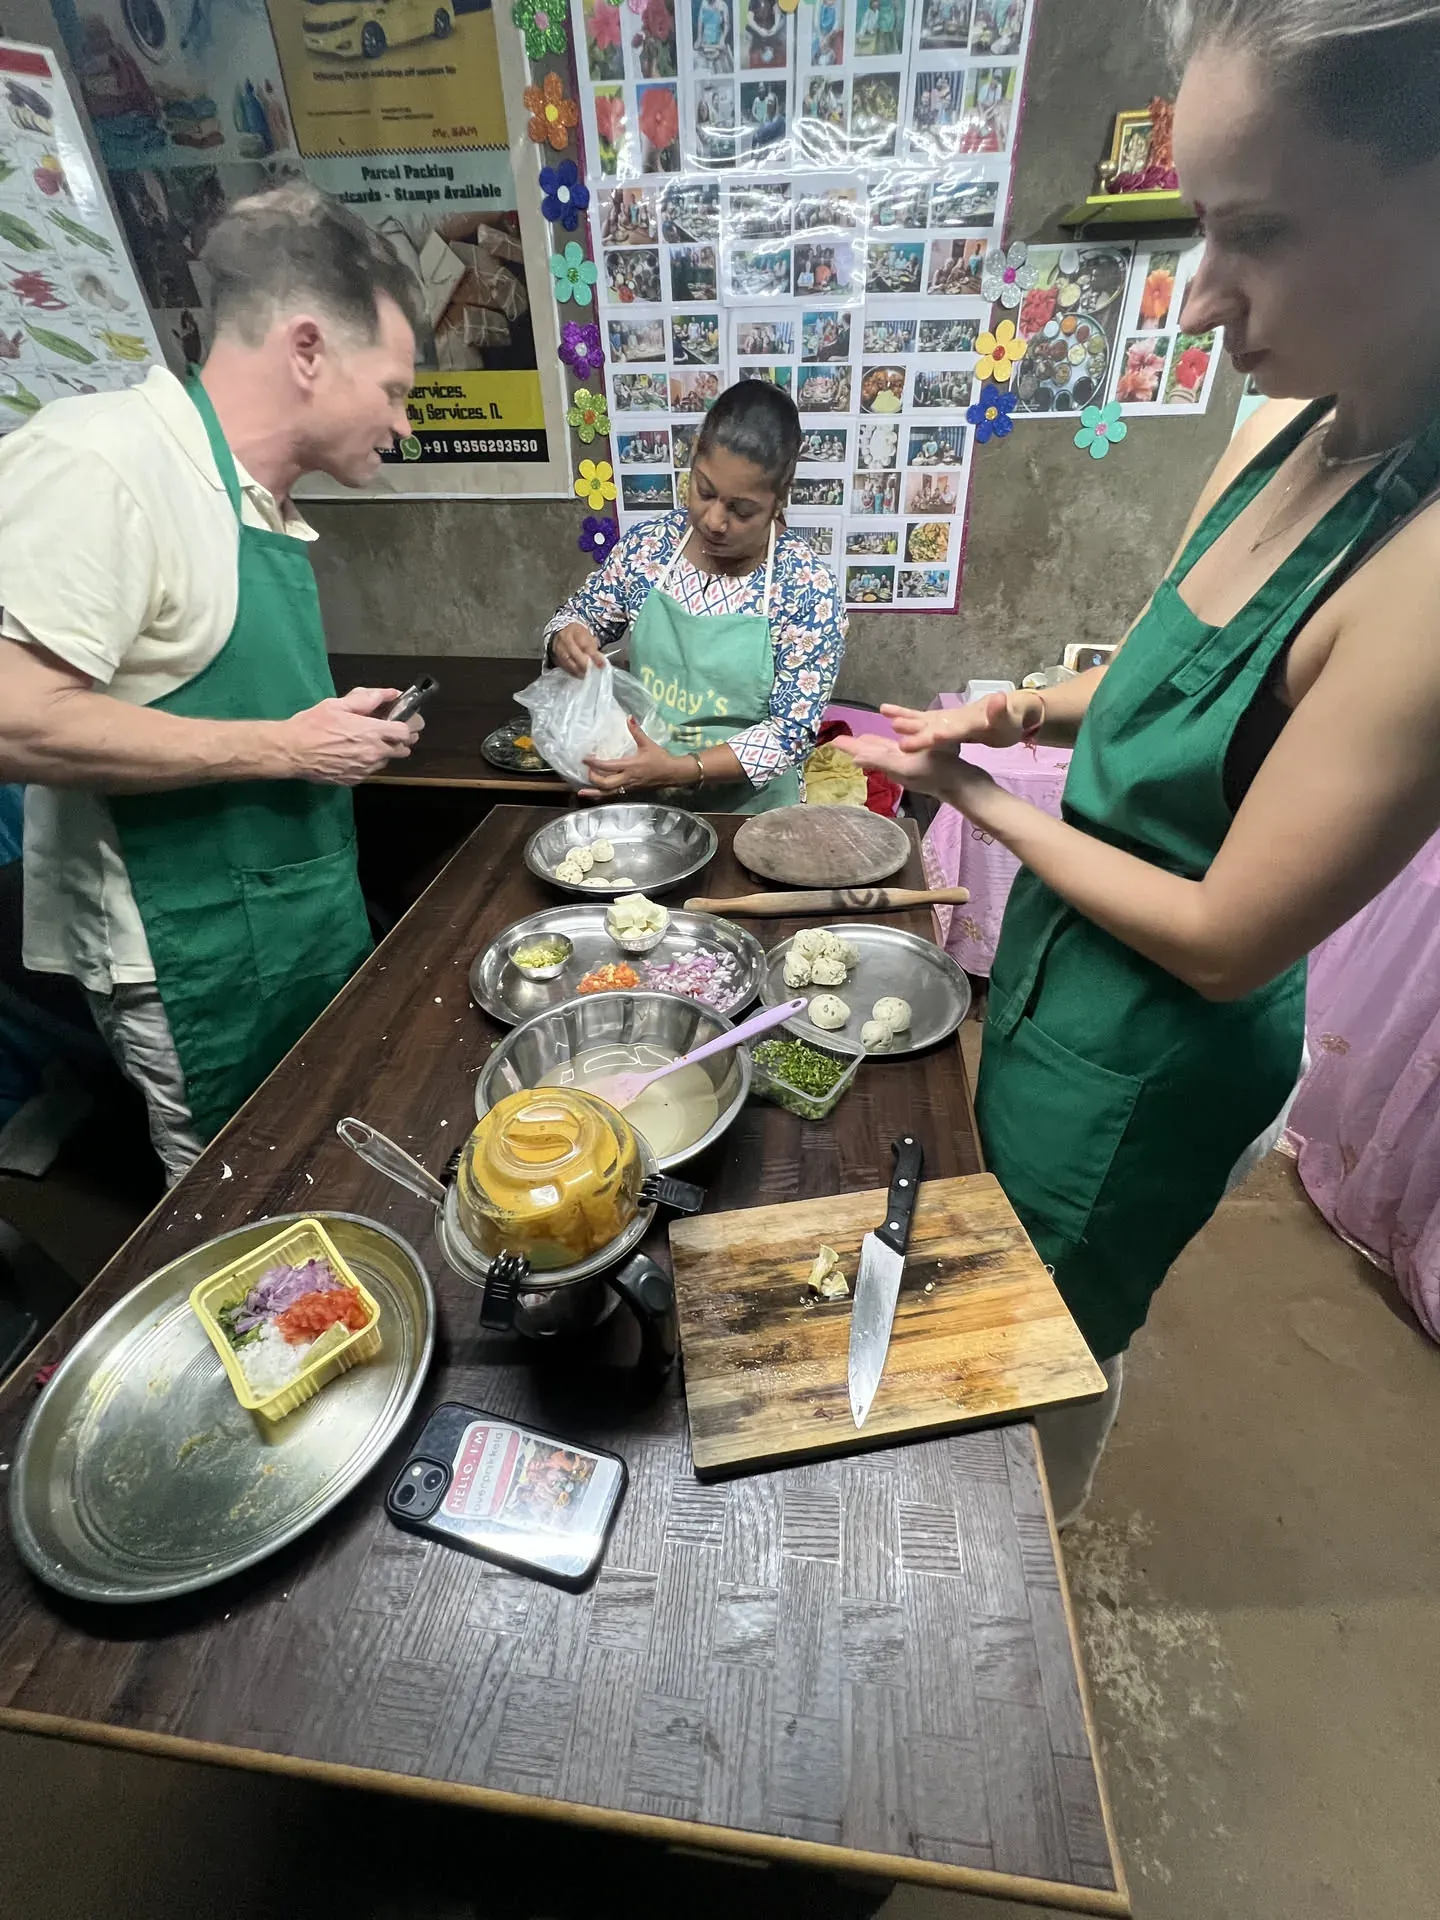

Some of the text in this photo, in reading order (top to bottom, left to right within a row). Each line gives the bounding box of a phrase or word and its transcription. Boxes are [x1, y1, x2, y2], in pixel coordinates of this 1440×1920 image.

[361, 164, 454, 181] Parcel Packing
[394, 187, 440, 203] Stamps
[444, 184, 502, 200] Available
[424, 439, 538, 453] +91 9356293530
[640, 666, 729, 717] Today's
[450, 1431, 485, 1508] HELLO, I'M
